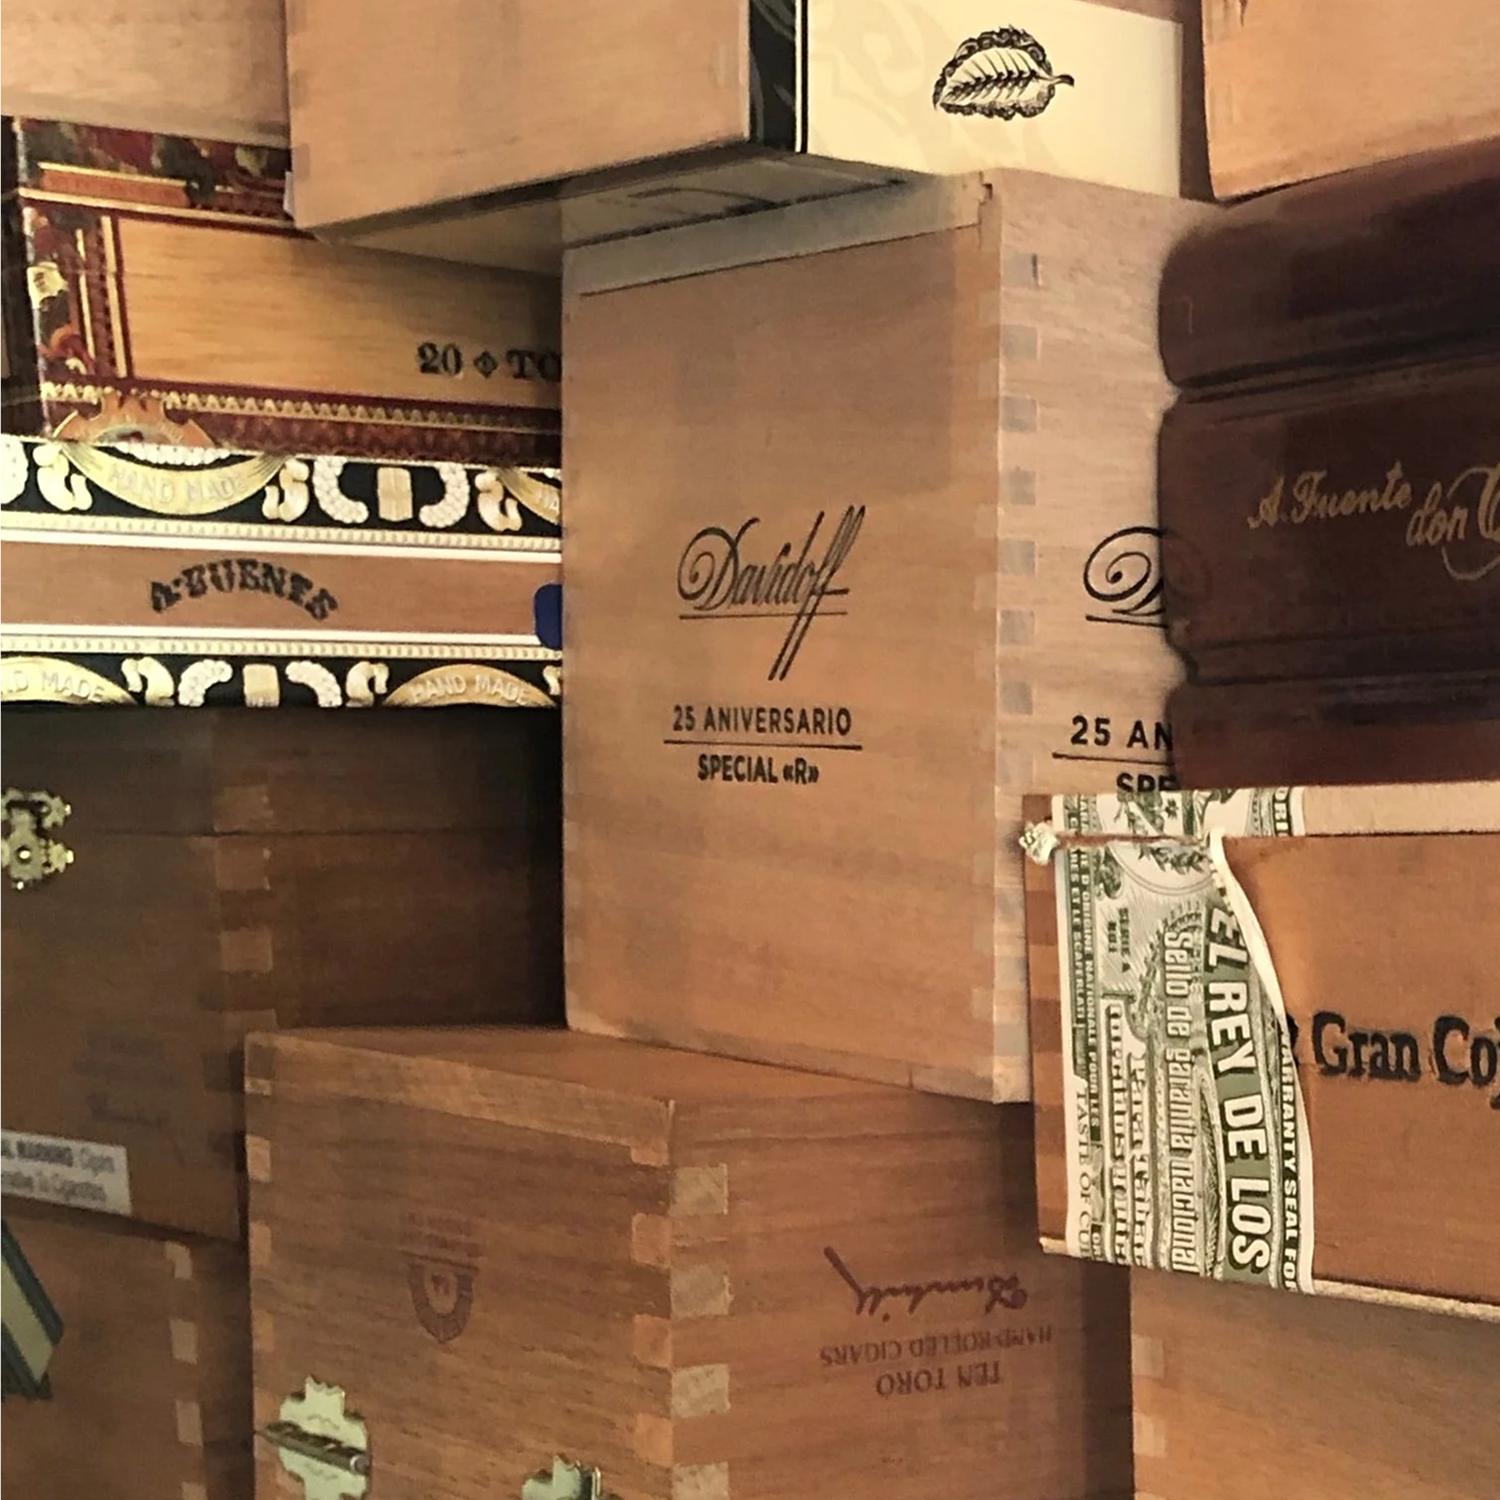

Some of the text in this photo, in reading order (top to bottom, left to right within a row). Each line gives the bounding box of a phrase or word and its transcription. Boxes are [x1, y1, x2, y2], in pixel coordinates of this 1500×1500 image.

[417, 342, 462, 375] 20
[677, 505, 865, 682] Davidoff
[672, 705, 852, 736] 25 ANIVERSARIO
[1070, 715, 1111, 746] 25
[698, 754, 778, 783] SPECIAL
[1164, 931, 1195, 998] Sello
[1166, 1006, 1193, 1036] de
[1207, 980, 1258, 1076] REY
[1312, 1010, 1422, 1082] Gran
[1078, 1091, 1092, 1165] TASTE
[1222, 1093, 1268, 1161] DE
[1080, 1171, 1093, 1203] OF
[1169, 1158, 1202, 1273] nacional
[1283, 1179, 1299, 1242] SEAL
[1228, 1176, 1273, 1272] LOS
[819, 1339, 902, 1367] CIGARS
[875, 1367, 948, 1398] TORO
